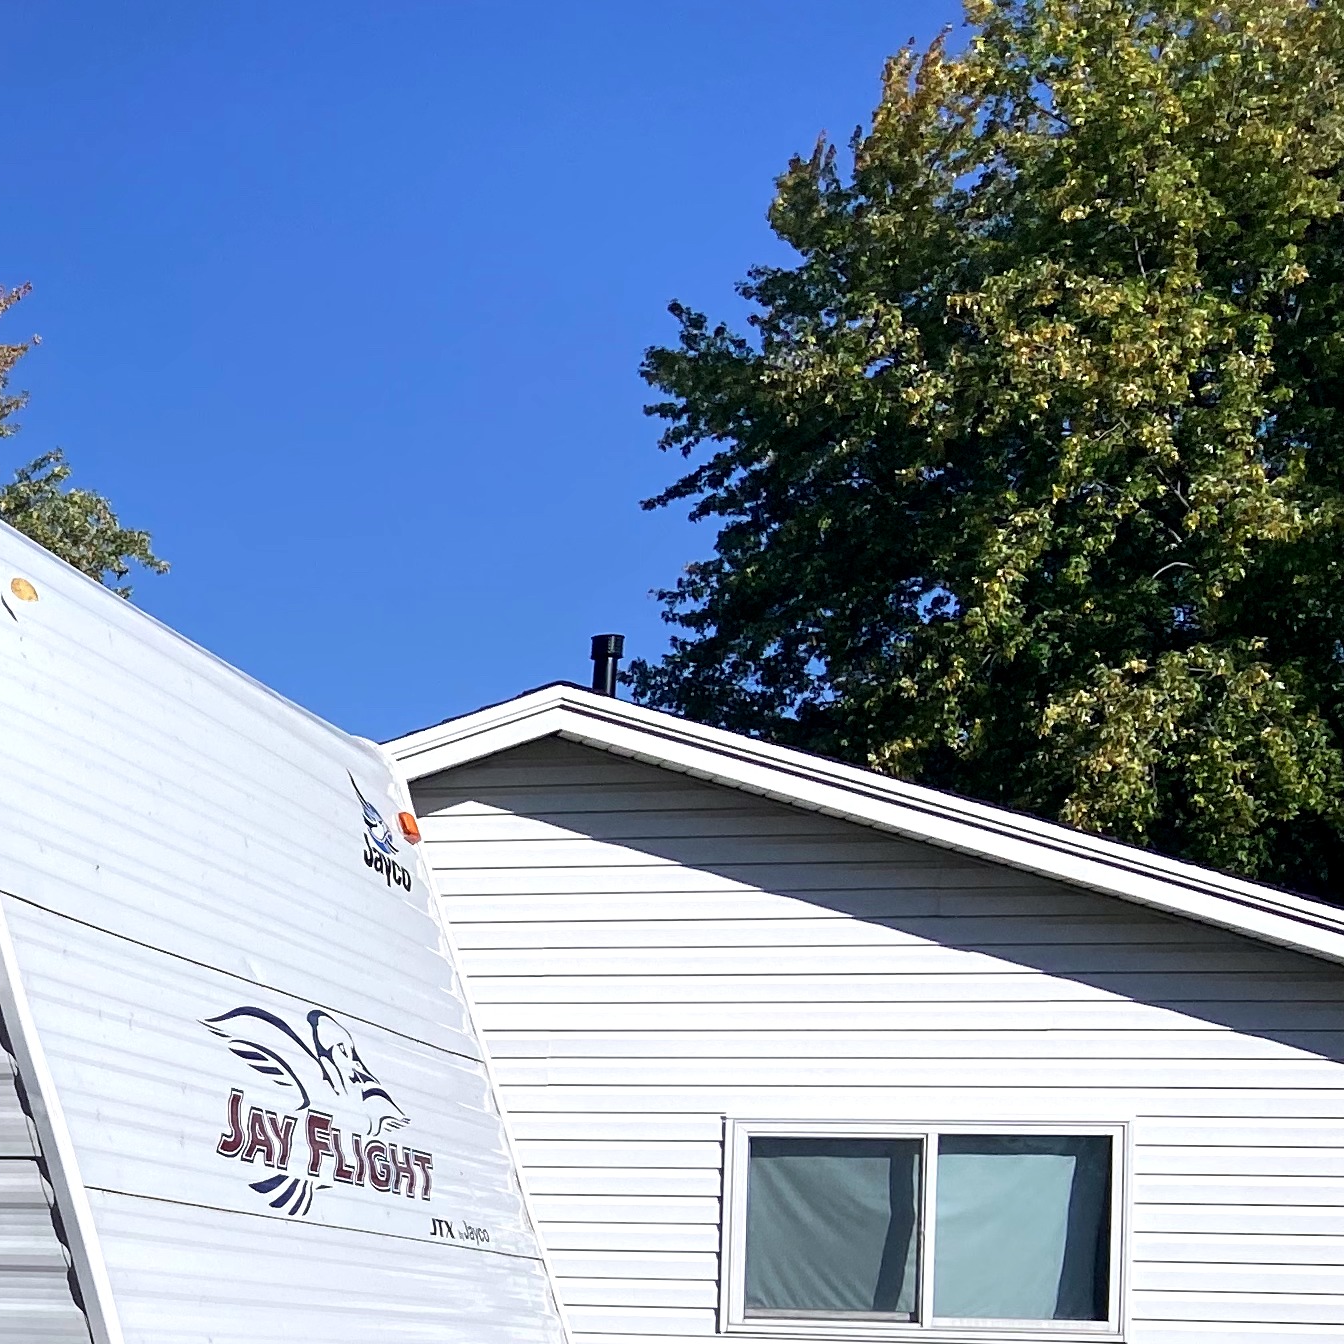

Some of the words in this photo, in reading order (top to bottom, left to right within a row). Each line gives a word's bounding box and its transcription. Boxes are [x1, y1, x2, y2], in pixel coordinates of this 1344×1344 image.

[363, 832, 412, 892] Jayco
[216, 1088, 298, 1170] JAY
[307, 1109, 433, 1200] FLIGHT
[430, 1217, 455, 1239] JTX
[462, 1219, 490, 1246] Jayco
